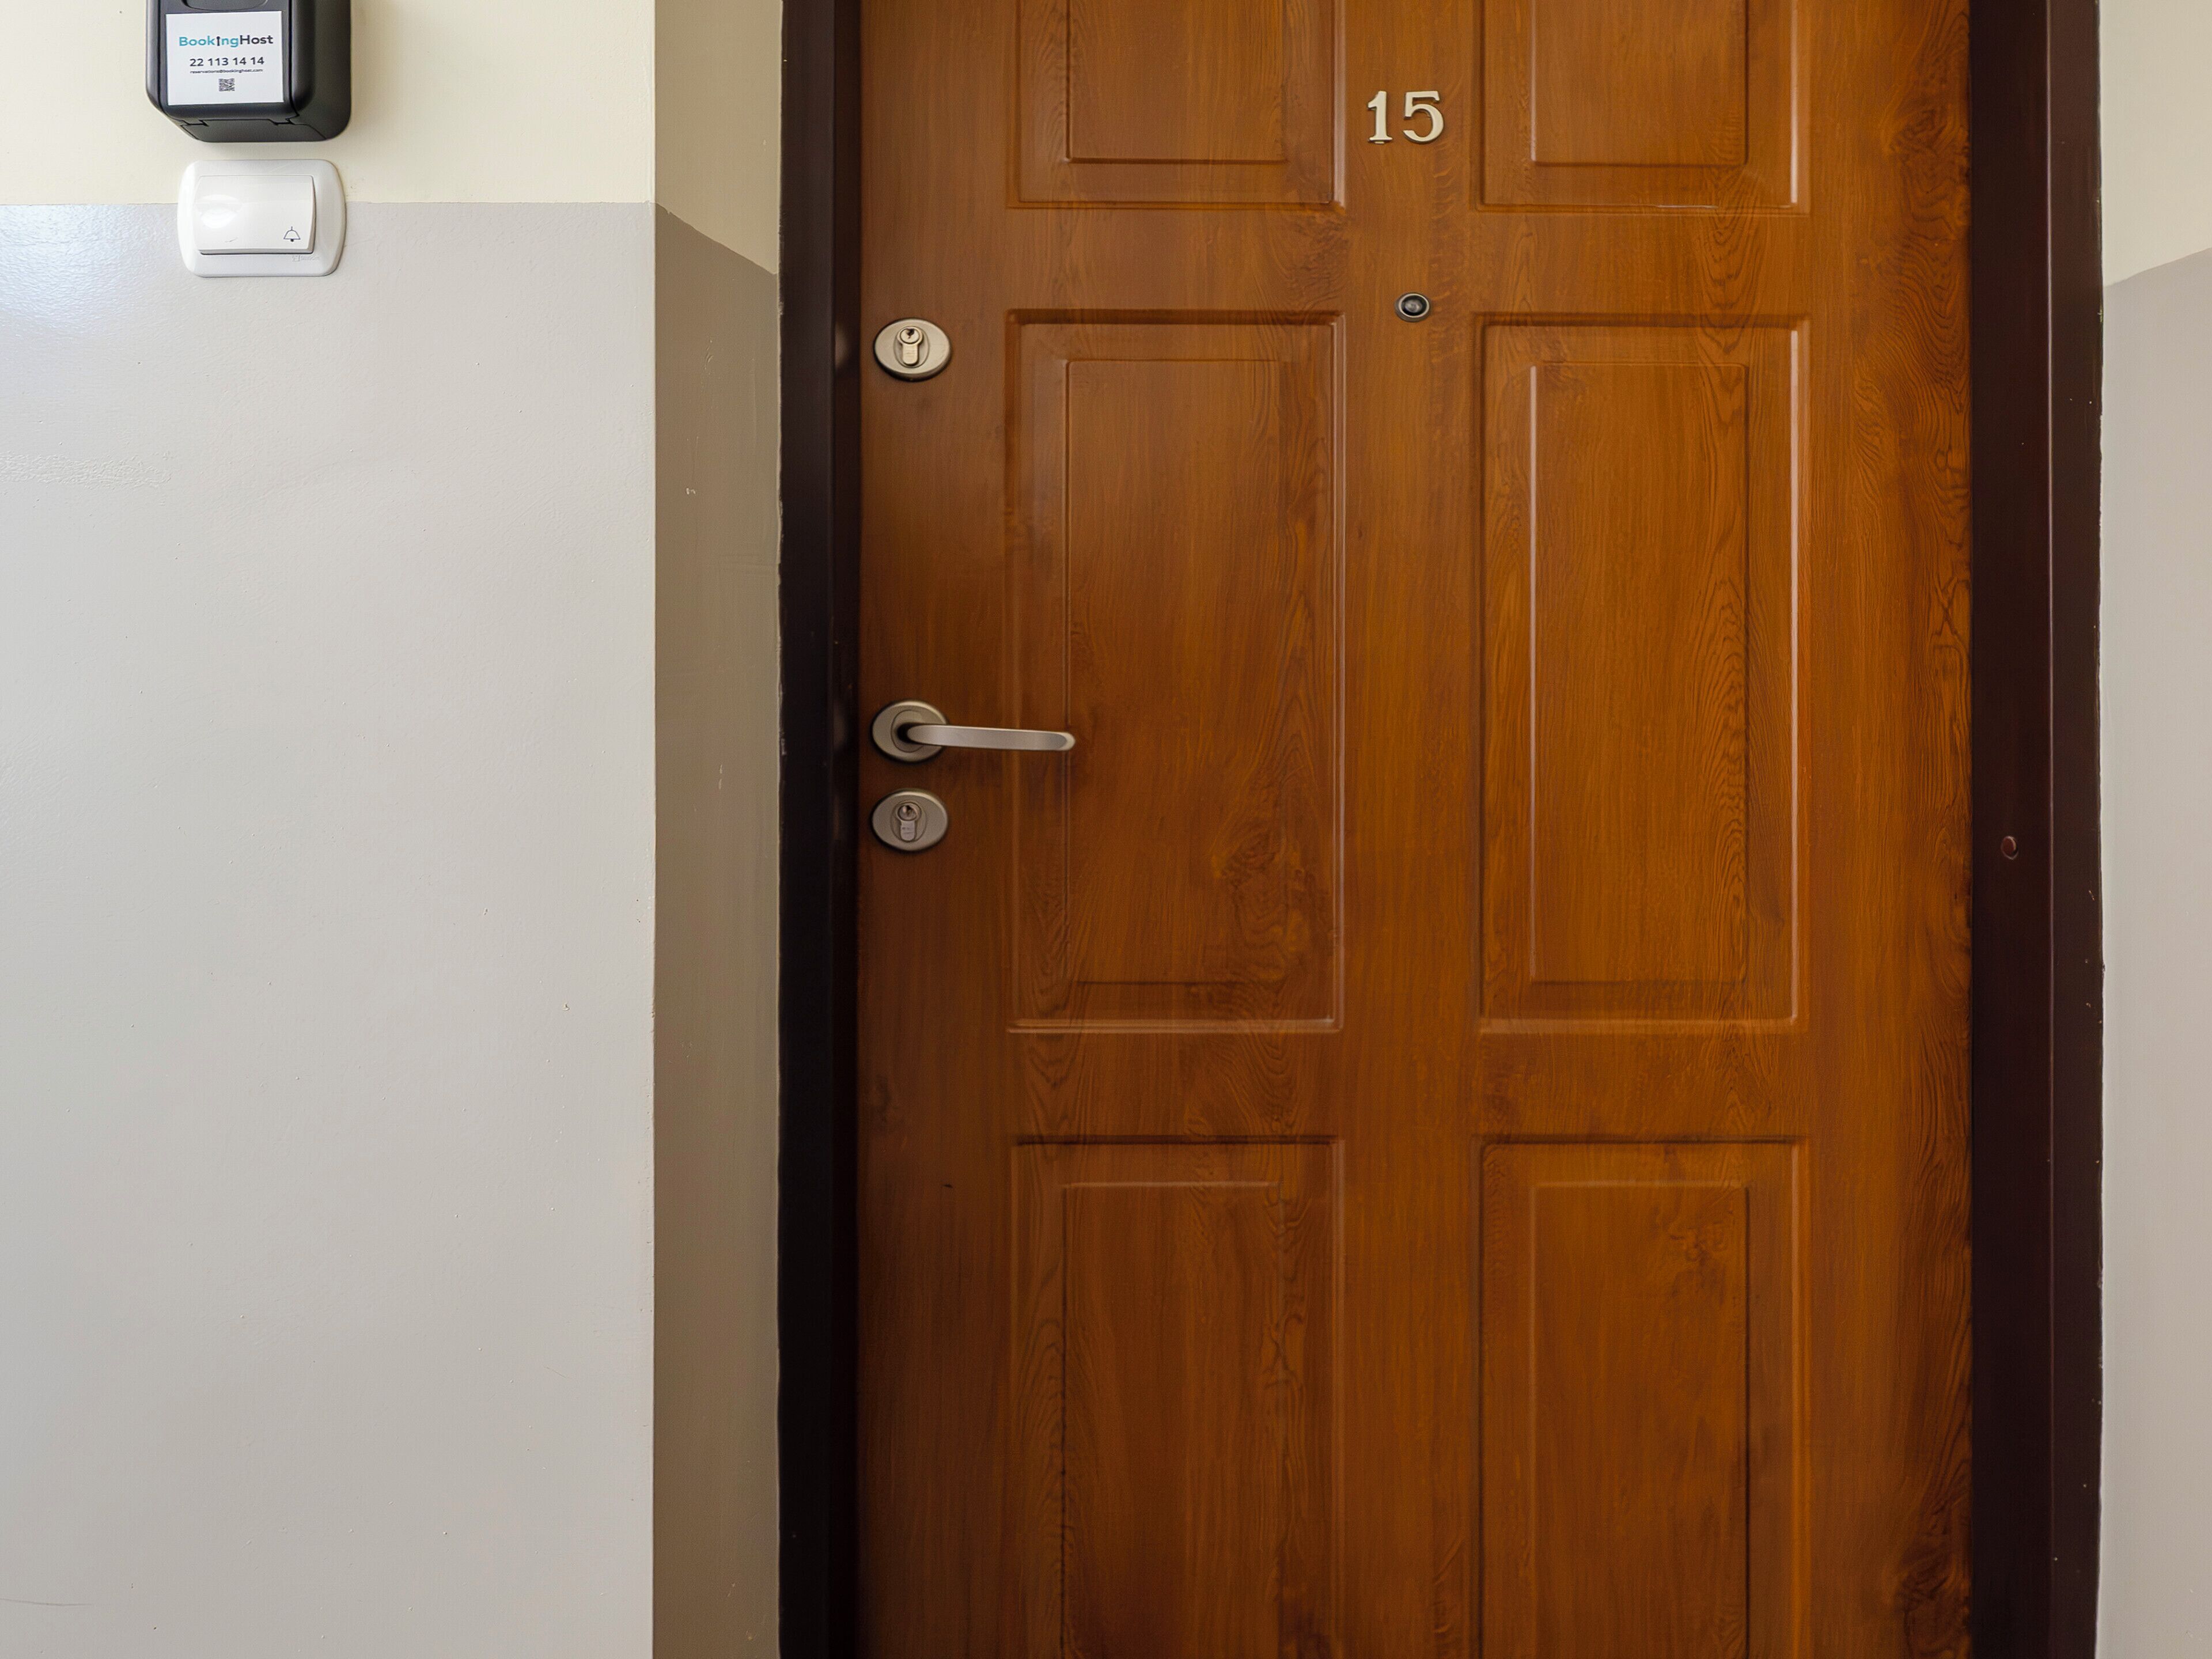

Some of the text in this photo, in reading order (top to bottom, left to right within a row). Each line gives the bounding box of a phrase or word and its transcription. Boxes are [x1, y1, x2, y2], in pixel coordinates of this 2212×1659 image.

[179, 35, 274, 48] BookingHost
[190, 56, 264, 66] 22 113 14 14
[1368, 90, 1444, 143] 15
